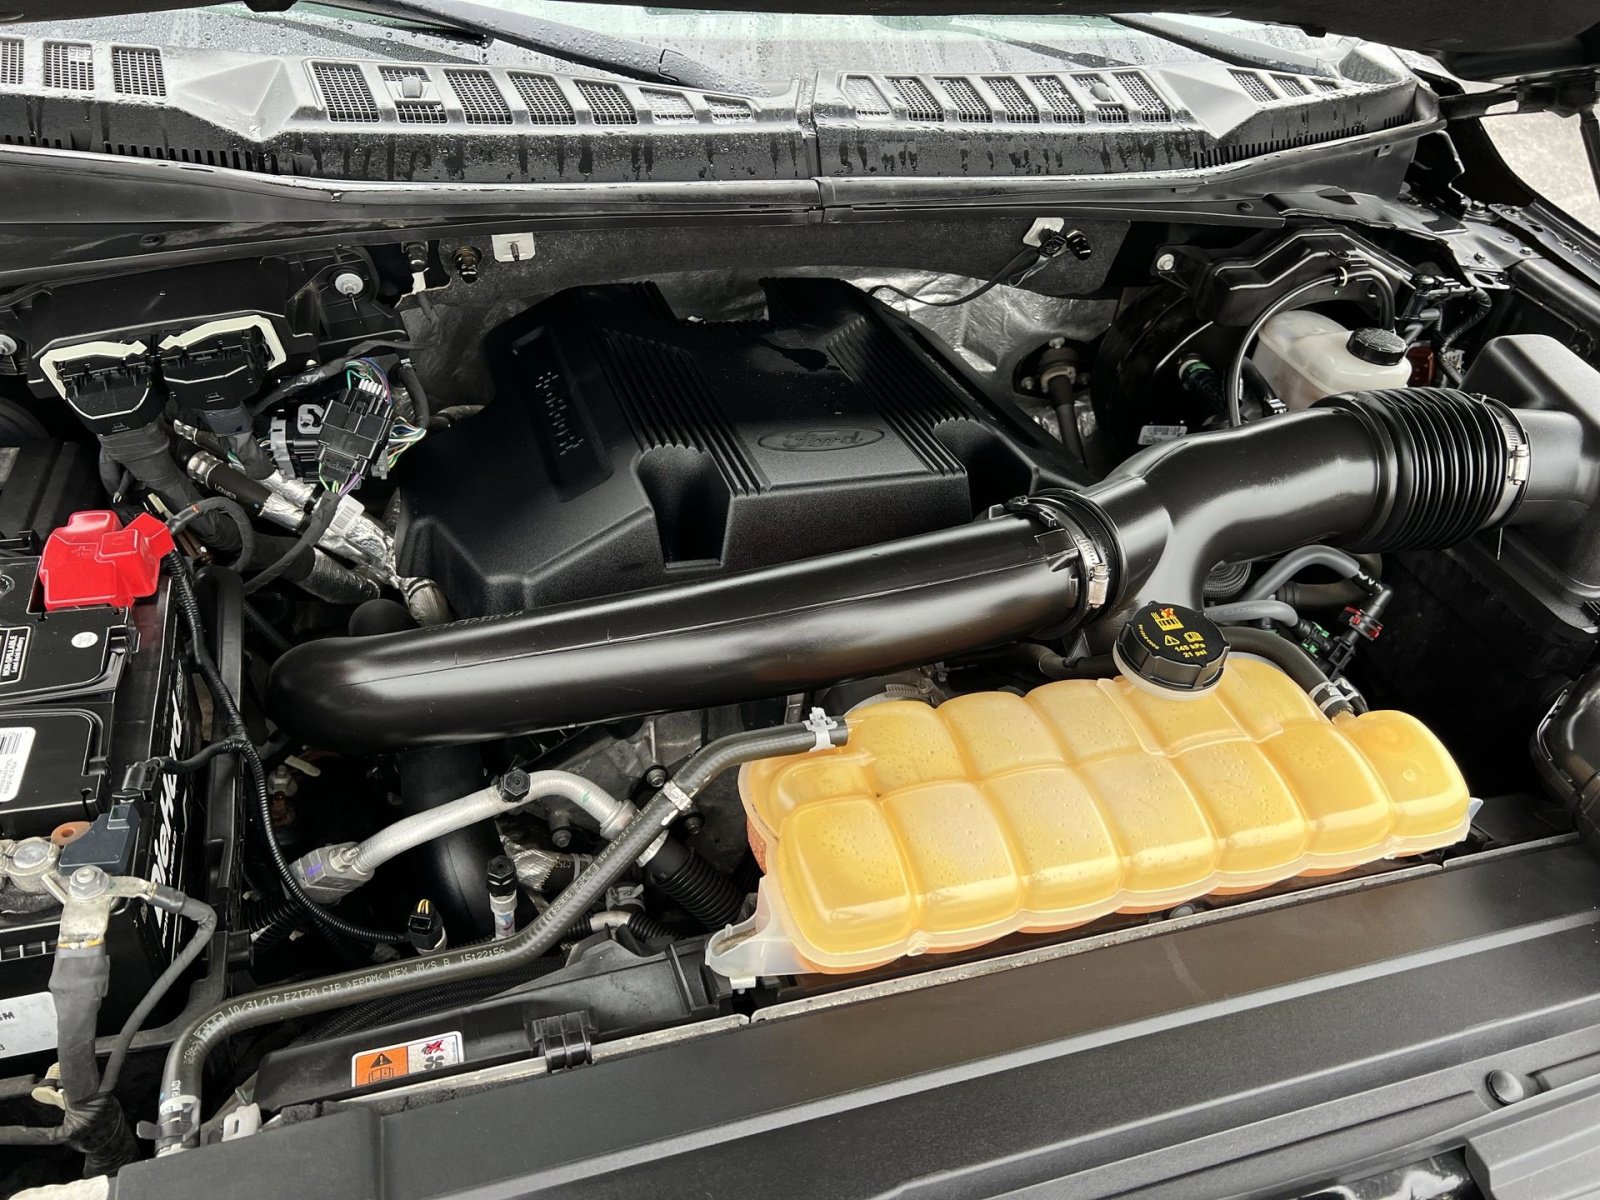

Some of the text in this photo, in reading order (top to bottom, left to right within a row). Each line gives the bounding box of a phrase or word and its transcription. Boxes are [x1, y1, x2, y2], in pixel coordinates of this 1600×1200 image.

[782, 430, 864, 449] Ford
[228, 995, 279, 1016] 10/31/17
[388, 967, 408, 979] MEX
